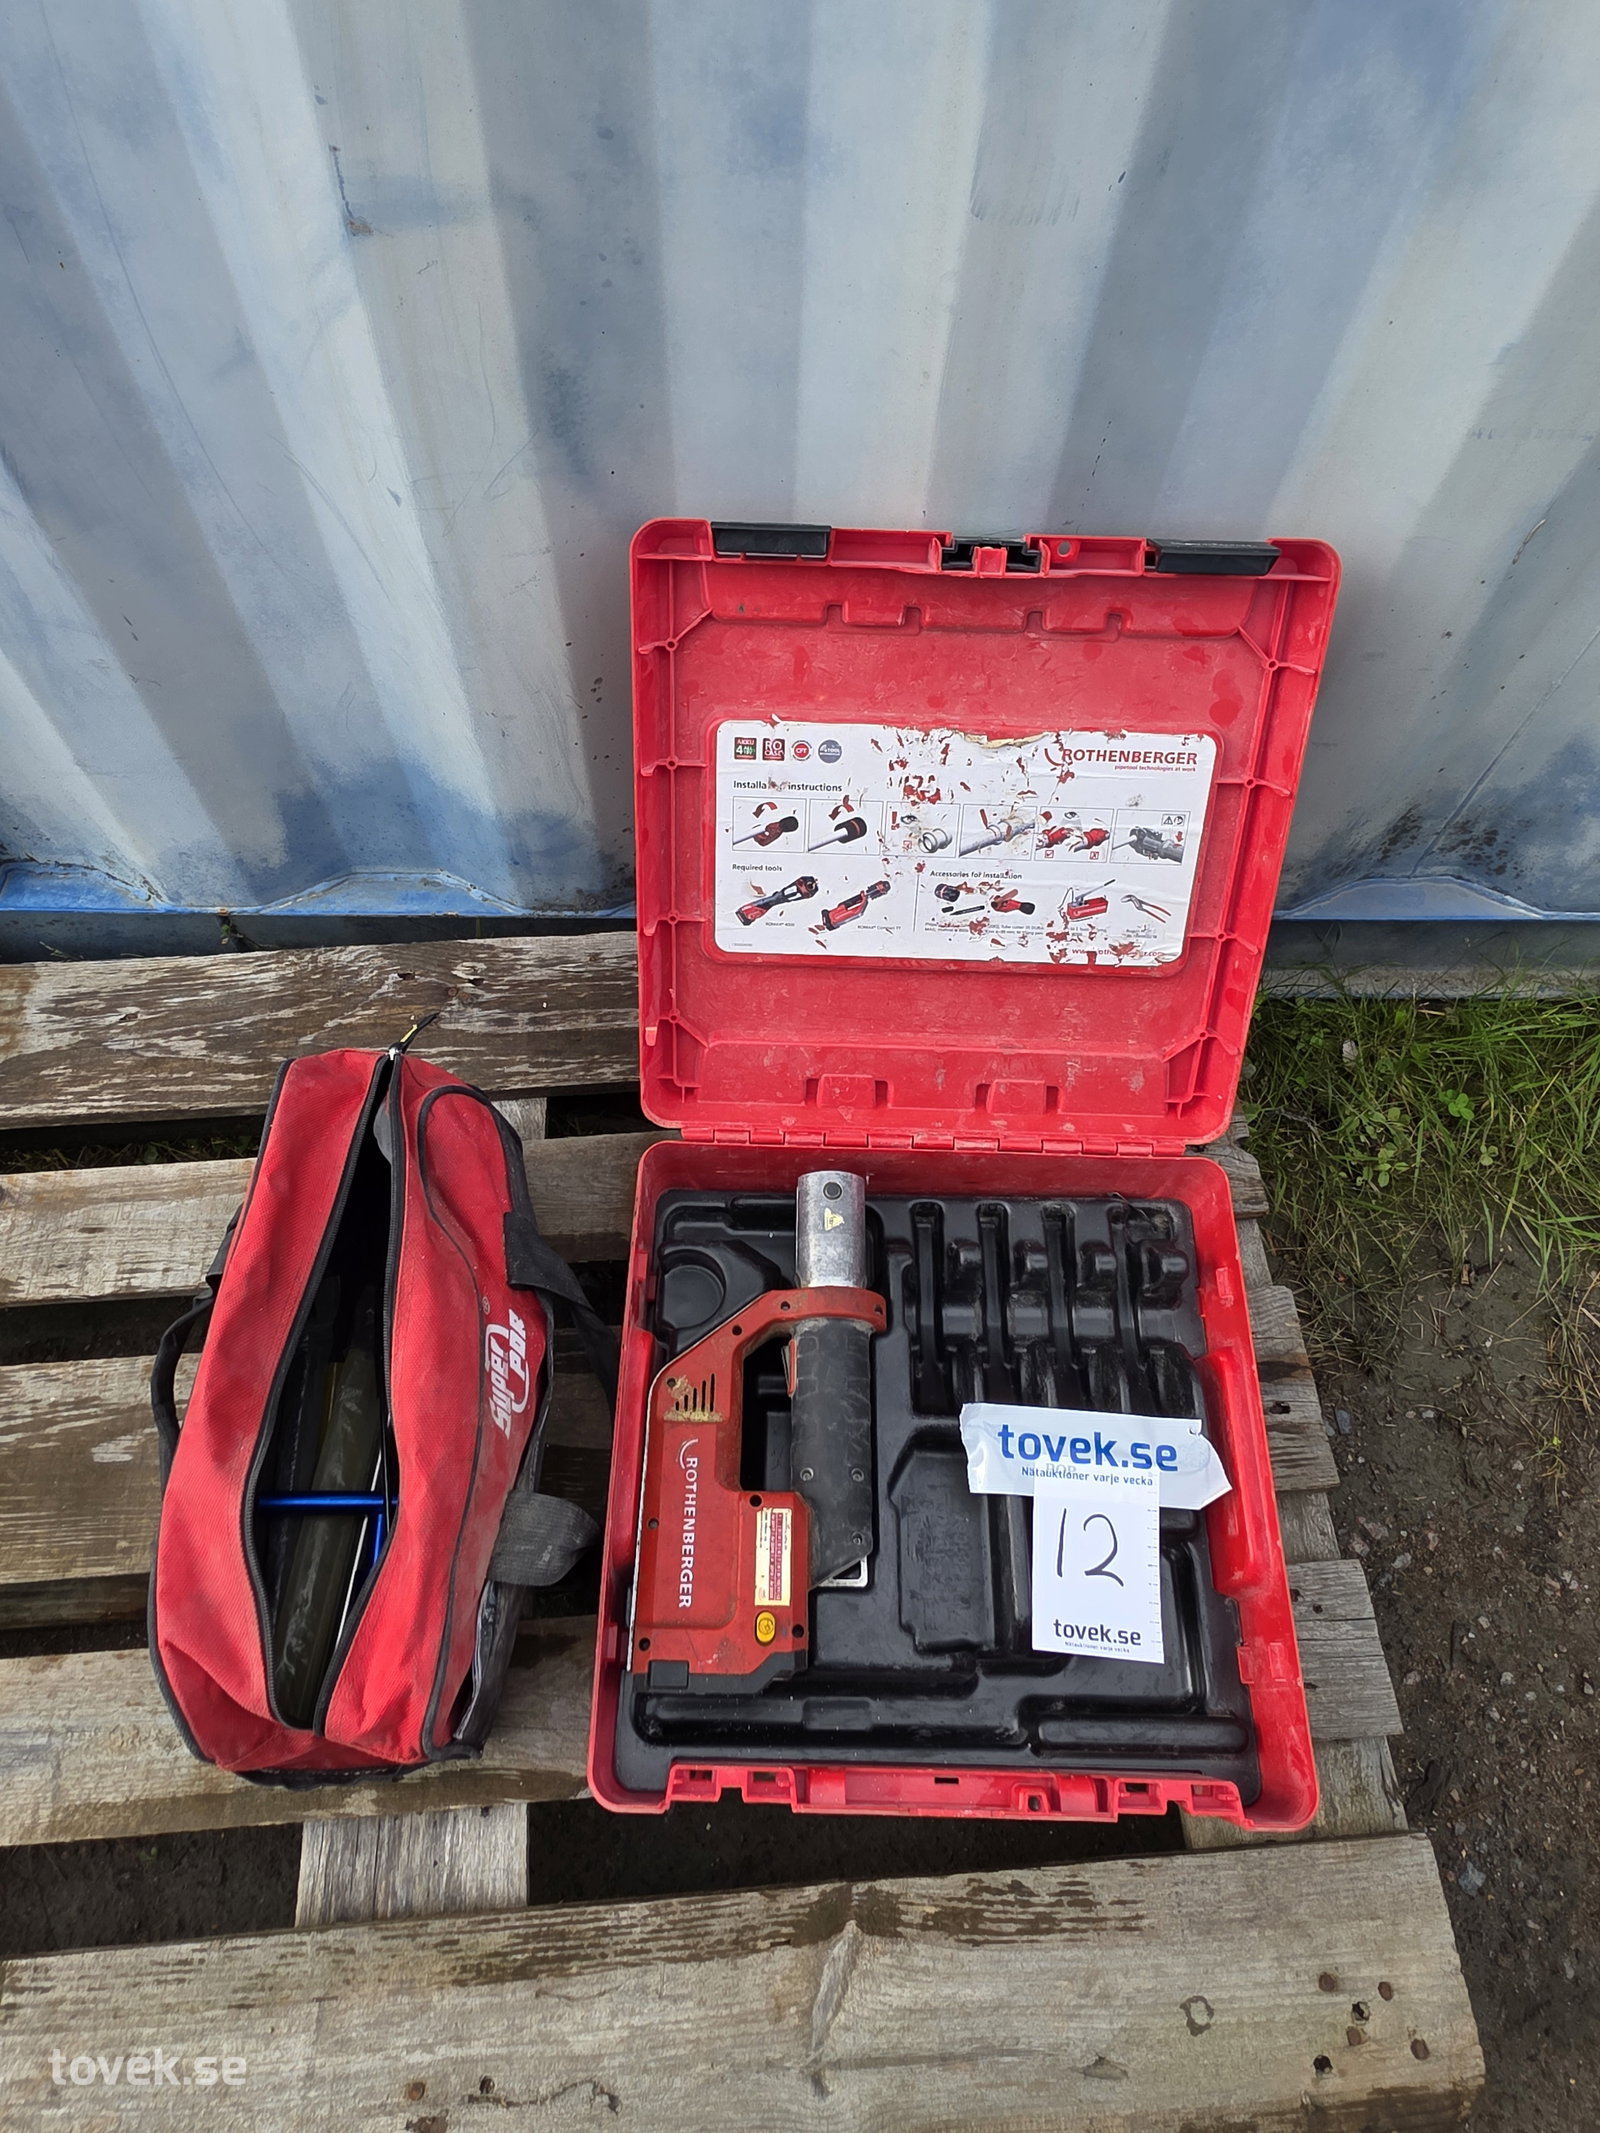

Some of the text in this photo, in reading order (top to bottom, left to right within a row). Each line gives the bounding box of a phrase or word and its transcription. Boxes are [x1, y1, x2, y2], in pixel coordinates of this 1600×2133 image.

[765, 740, 782, 751] RO
[1062, 749, 1198, 765] ROTHENBERGER
[788, 782, 843, 792] instructions
[732, 864, 763, 872] Required
[930, 870, 969, 878] Accessories
[997, 1424, 1178, 1472] tovek.se
[1021, 1466, 1153, 1486] Nätauktioner varje vecka
[678, 1457, 698, 1609] ROTHENBERGER
[1056, 1507, 1125, 1588] 12
[1053, 1618, 1142, 1646] tovek.se
